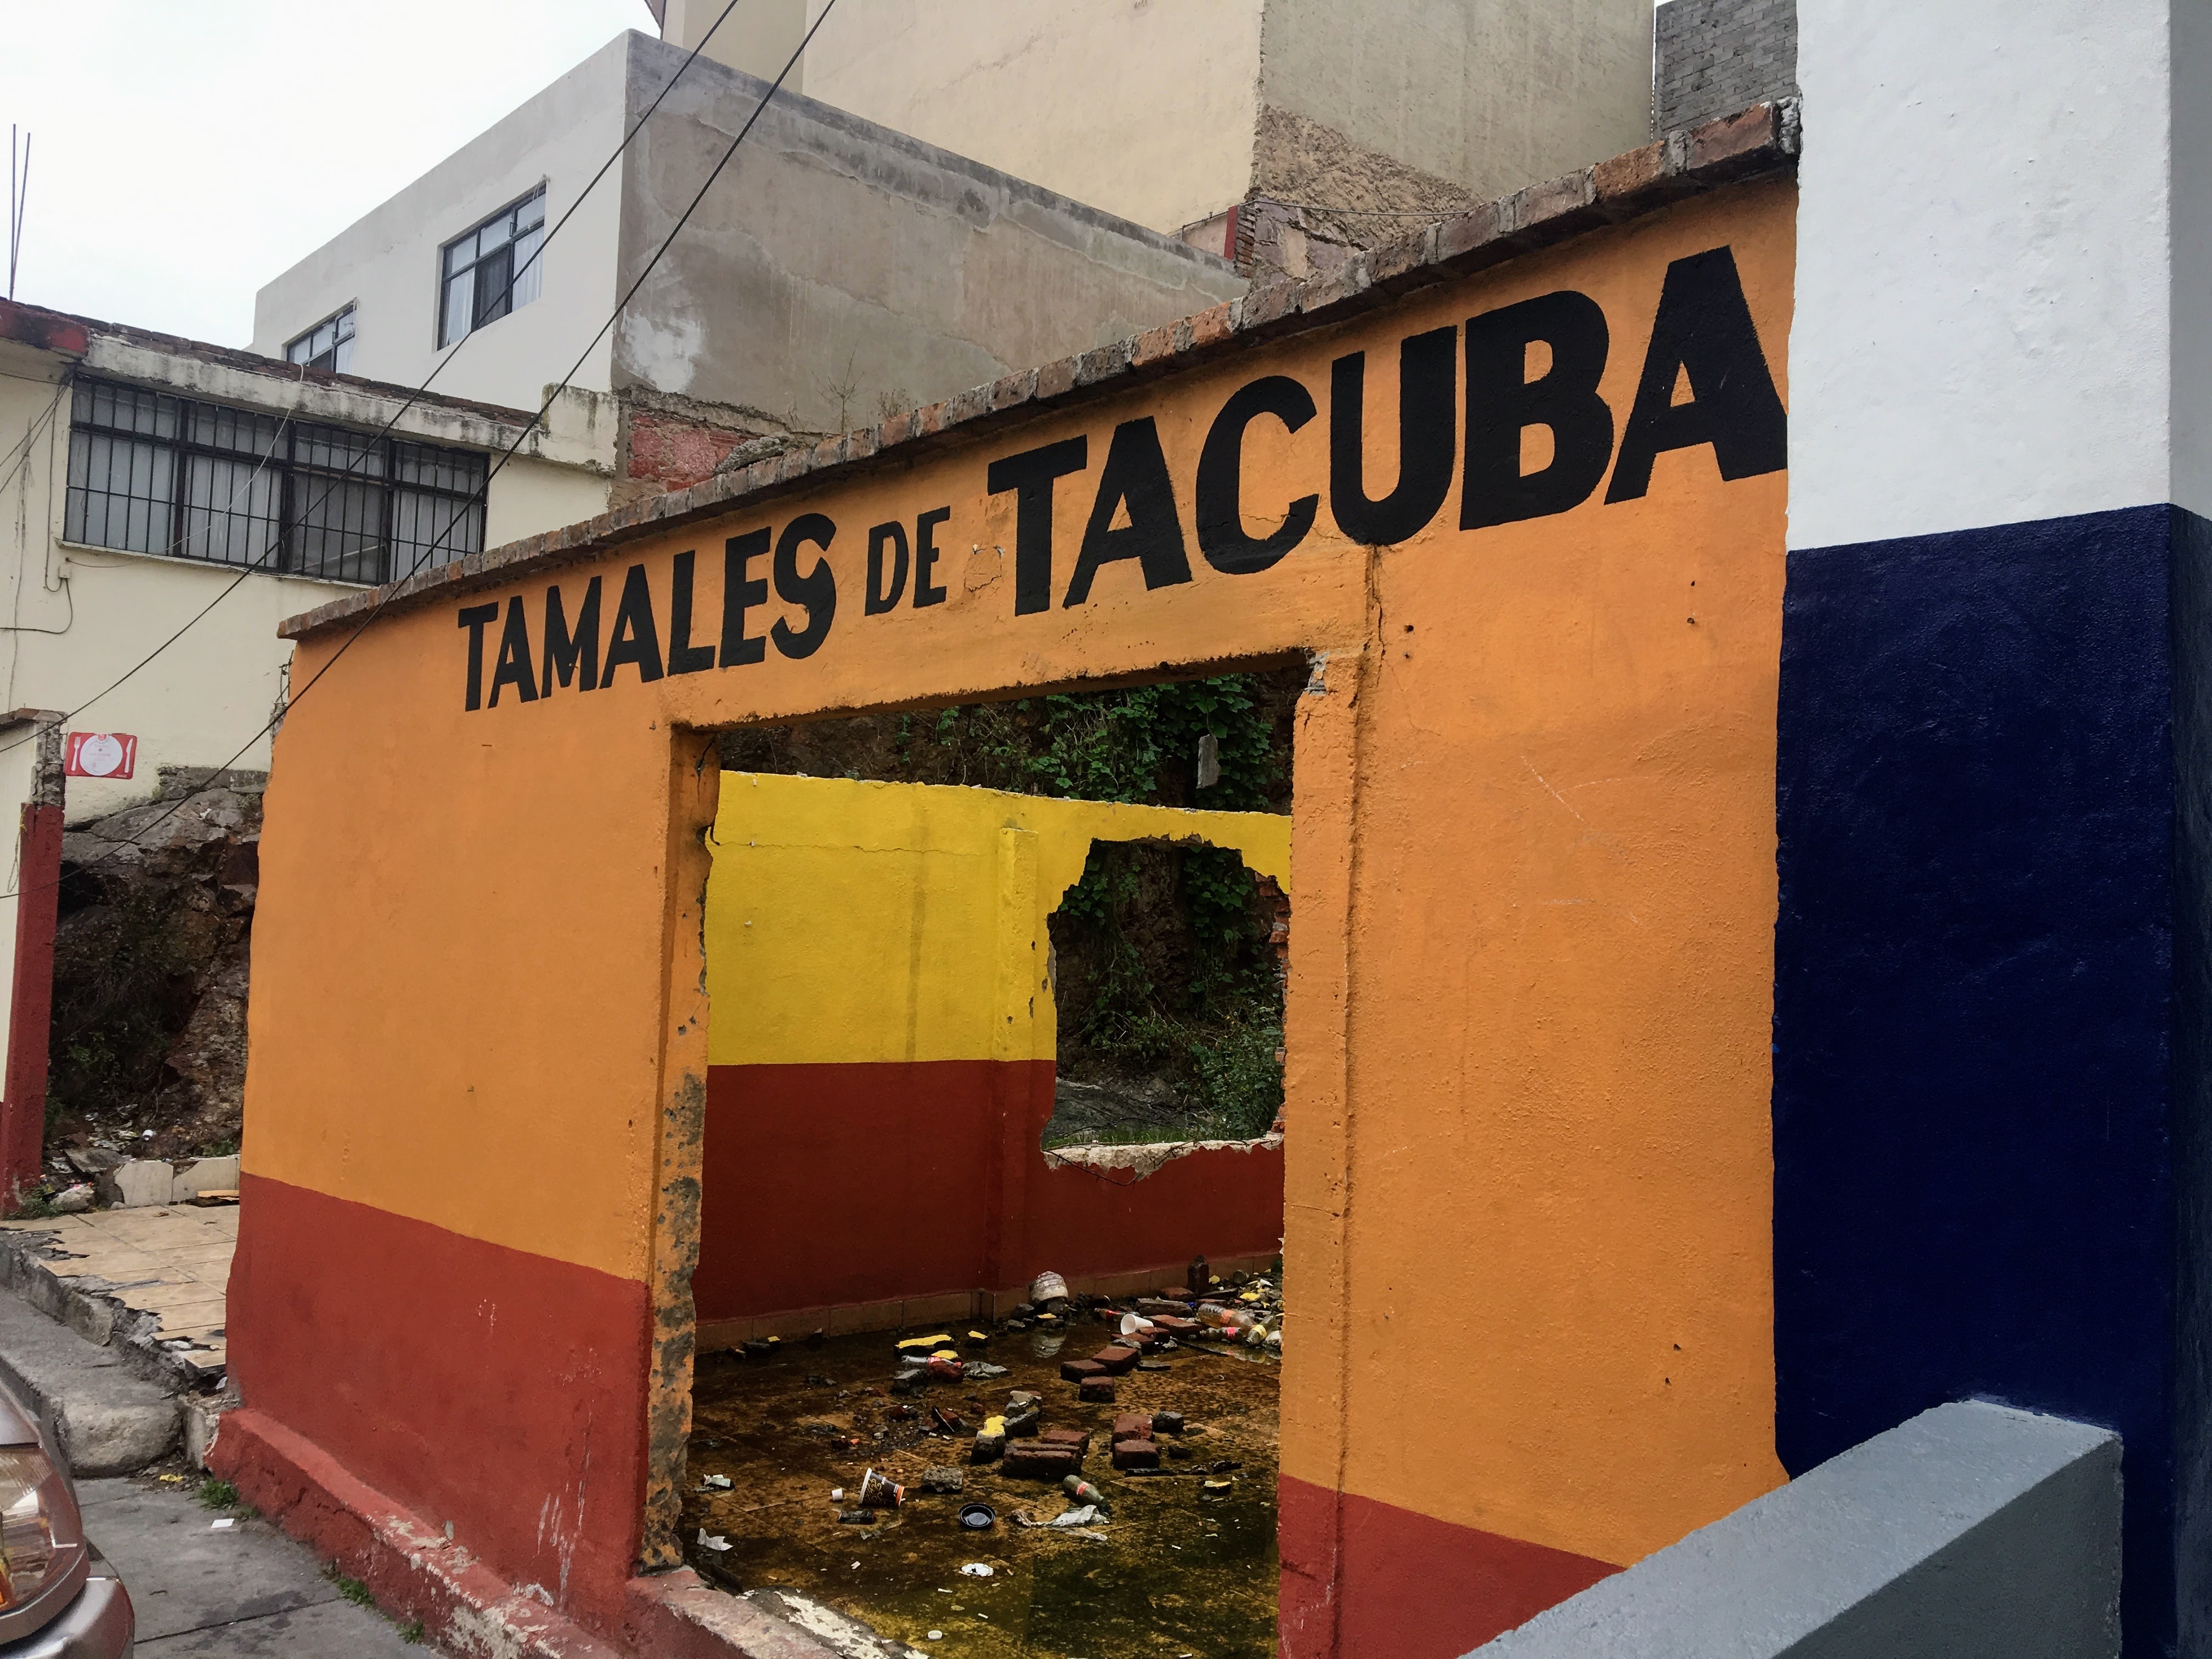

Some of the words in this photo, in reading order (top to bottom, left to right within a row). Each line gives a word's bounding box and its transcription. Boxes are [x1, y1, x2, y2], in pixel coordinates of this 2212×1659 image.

[458, 512, 837, 712] TAMALES
[865, 506, 950, 617] DE
[988, 245, 1787, 617] TACUBA
